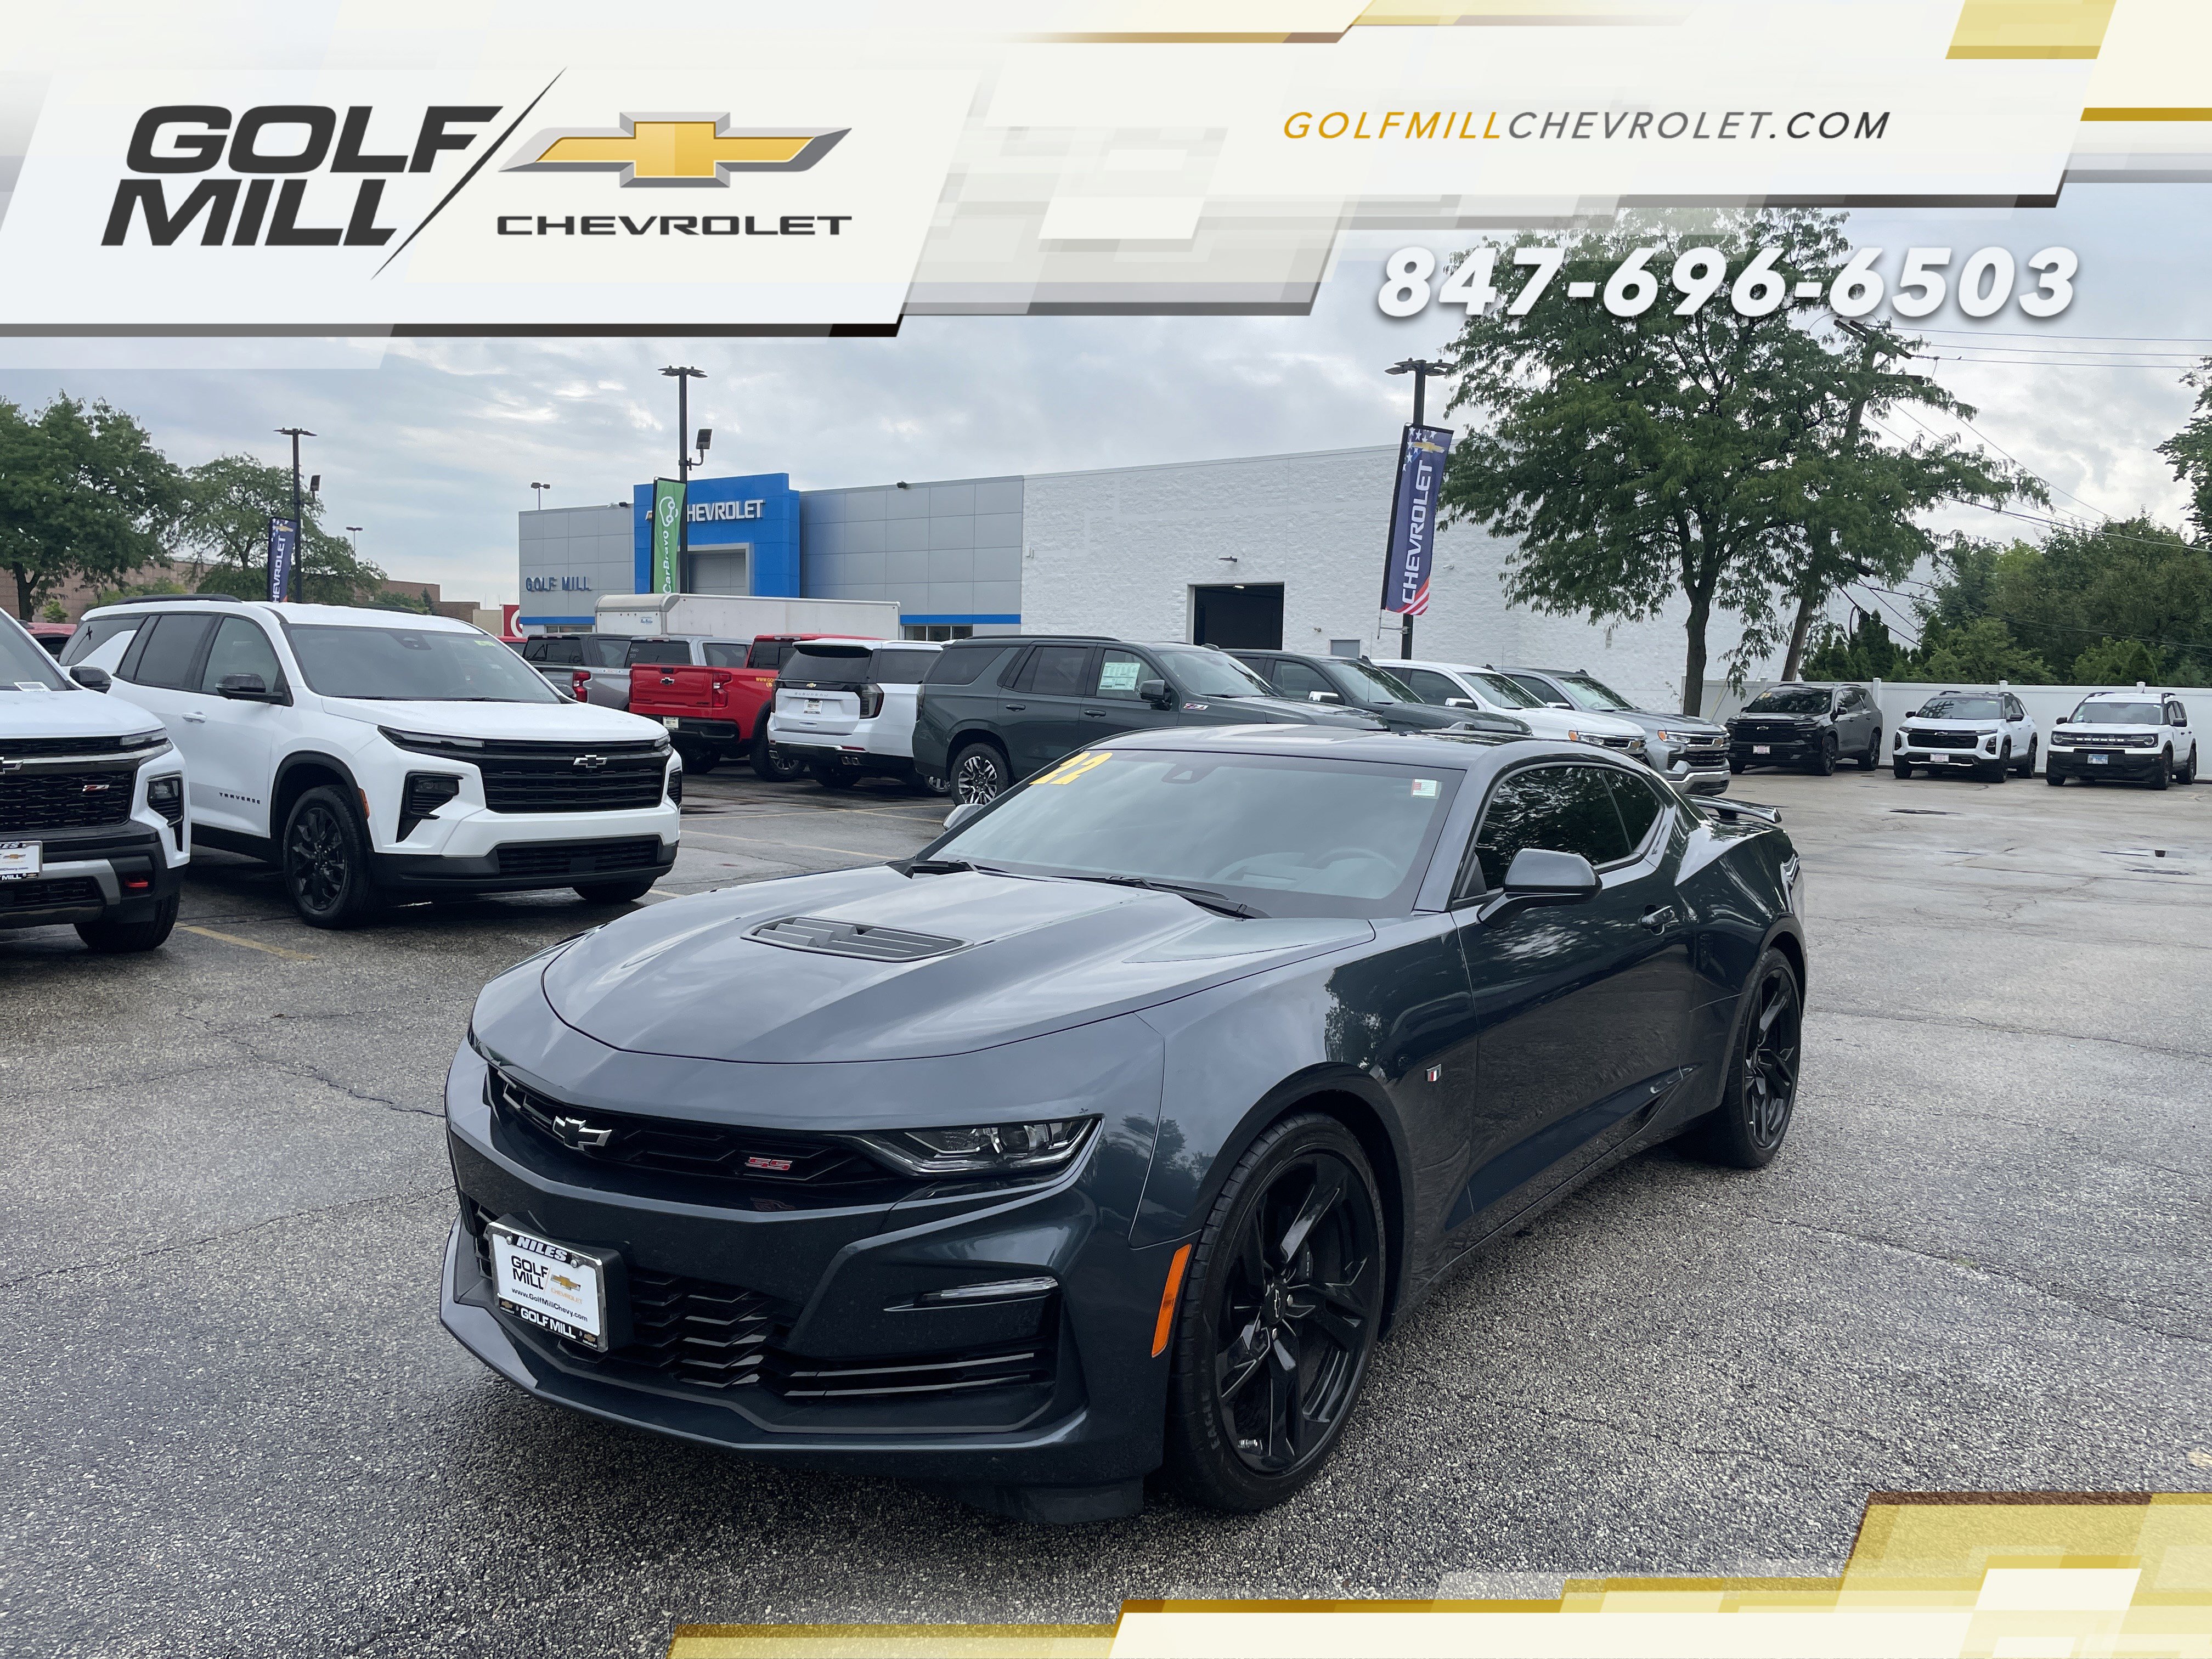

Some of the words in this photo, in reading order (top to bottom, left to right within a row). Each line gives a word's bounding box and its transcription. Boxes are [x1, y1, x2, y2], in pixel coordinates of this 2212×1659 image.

[687, 499, 765, 522] HEVROLET
[1402, 460, 1432, 603] CHEVROLET
[272, 535, 286, 603] HEVROLET
[662, 530, 672, 594] CarBravo
[526, 577, 557, 591] GOLF
[562, 576, 591, 591] MILL
[1029, 752, 1113, 785] 22
[744, 1156, 793, 1171] SS
[516, 1236, 567, 1262] NILES
[511, 1255, 549, 1278] GOLF
[512, 1267, 544, 1290] MILL
[511, 1288, 588, 1322] www.GolfMillChevy.com
[521, 1307, 549, 1327] GOLF
[550, 1319, 577, 1340] MILL
